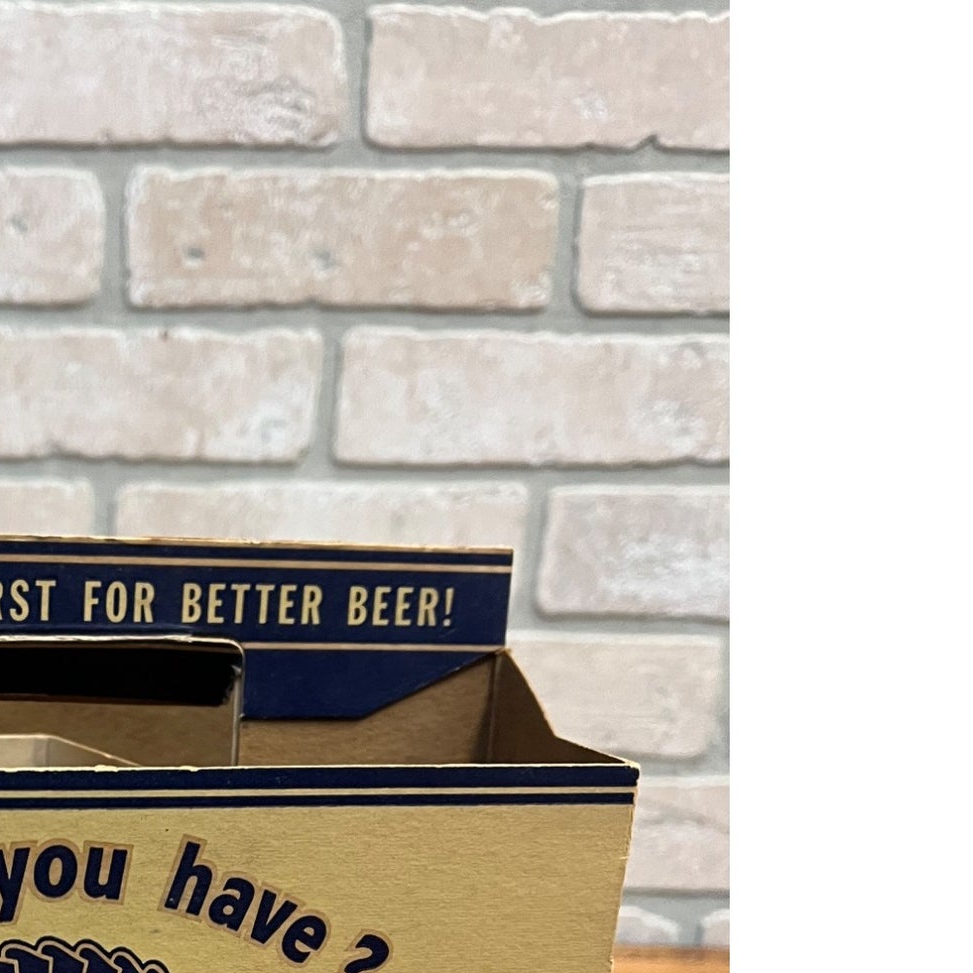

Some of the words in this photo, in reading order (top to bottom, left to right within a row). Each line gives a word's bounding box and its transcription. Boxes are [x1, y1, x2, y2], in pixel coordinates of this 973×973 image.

[84, 581, 155, 623] FOR
[181, 583, 322, 625] BETTER
[347, 586, 455, 627] BEER!
